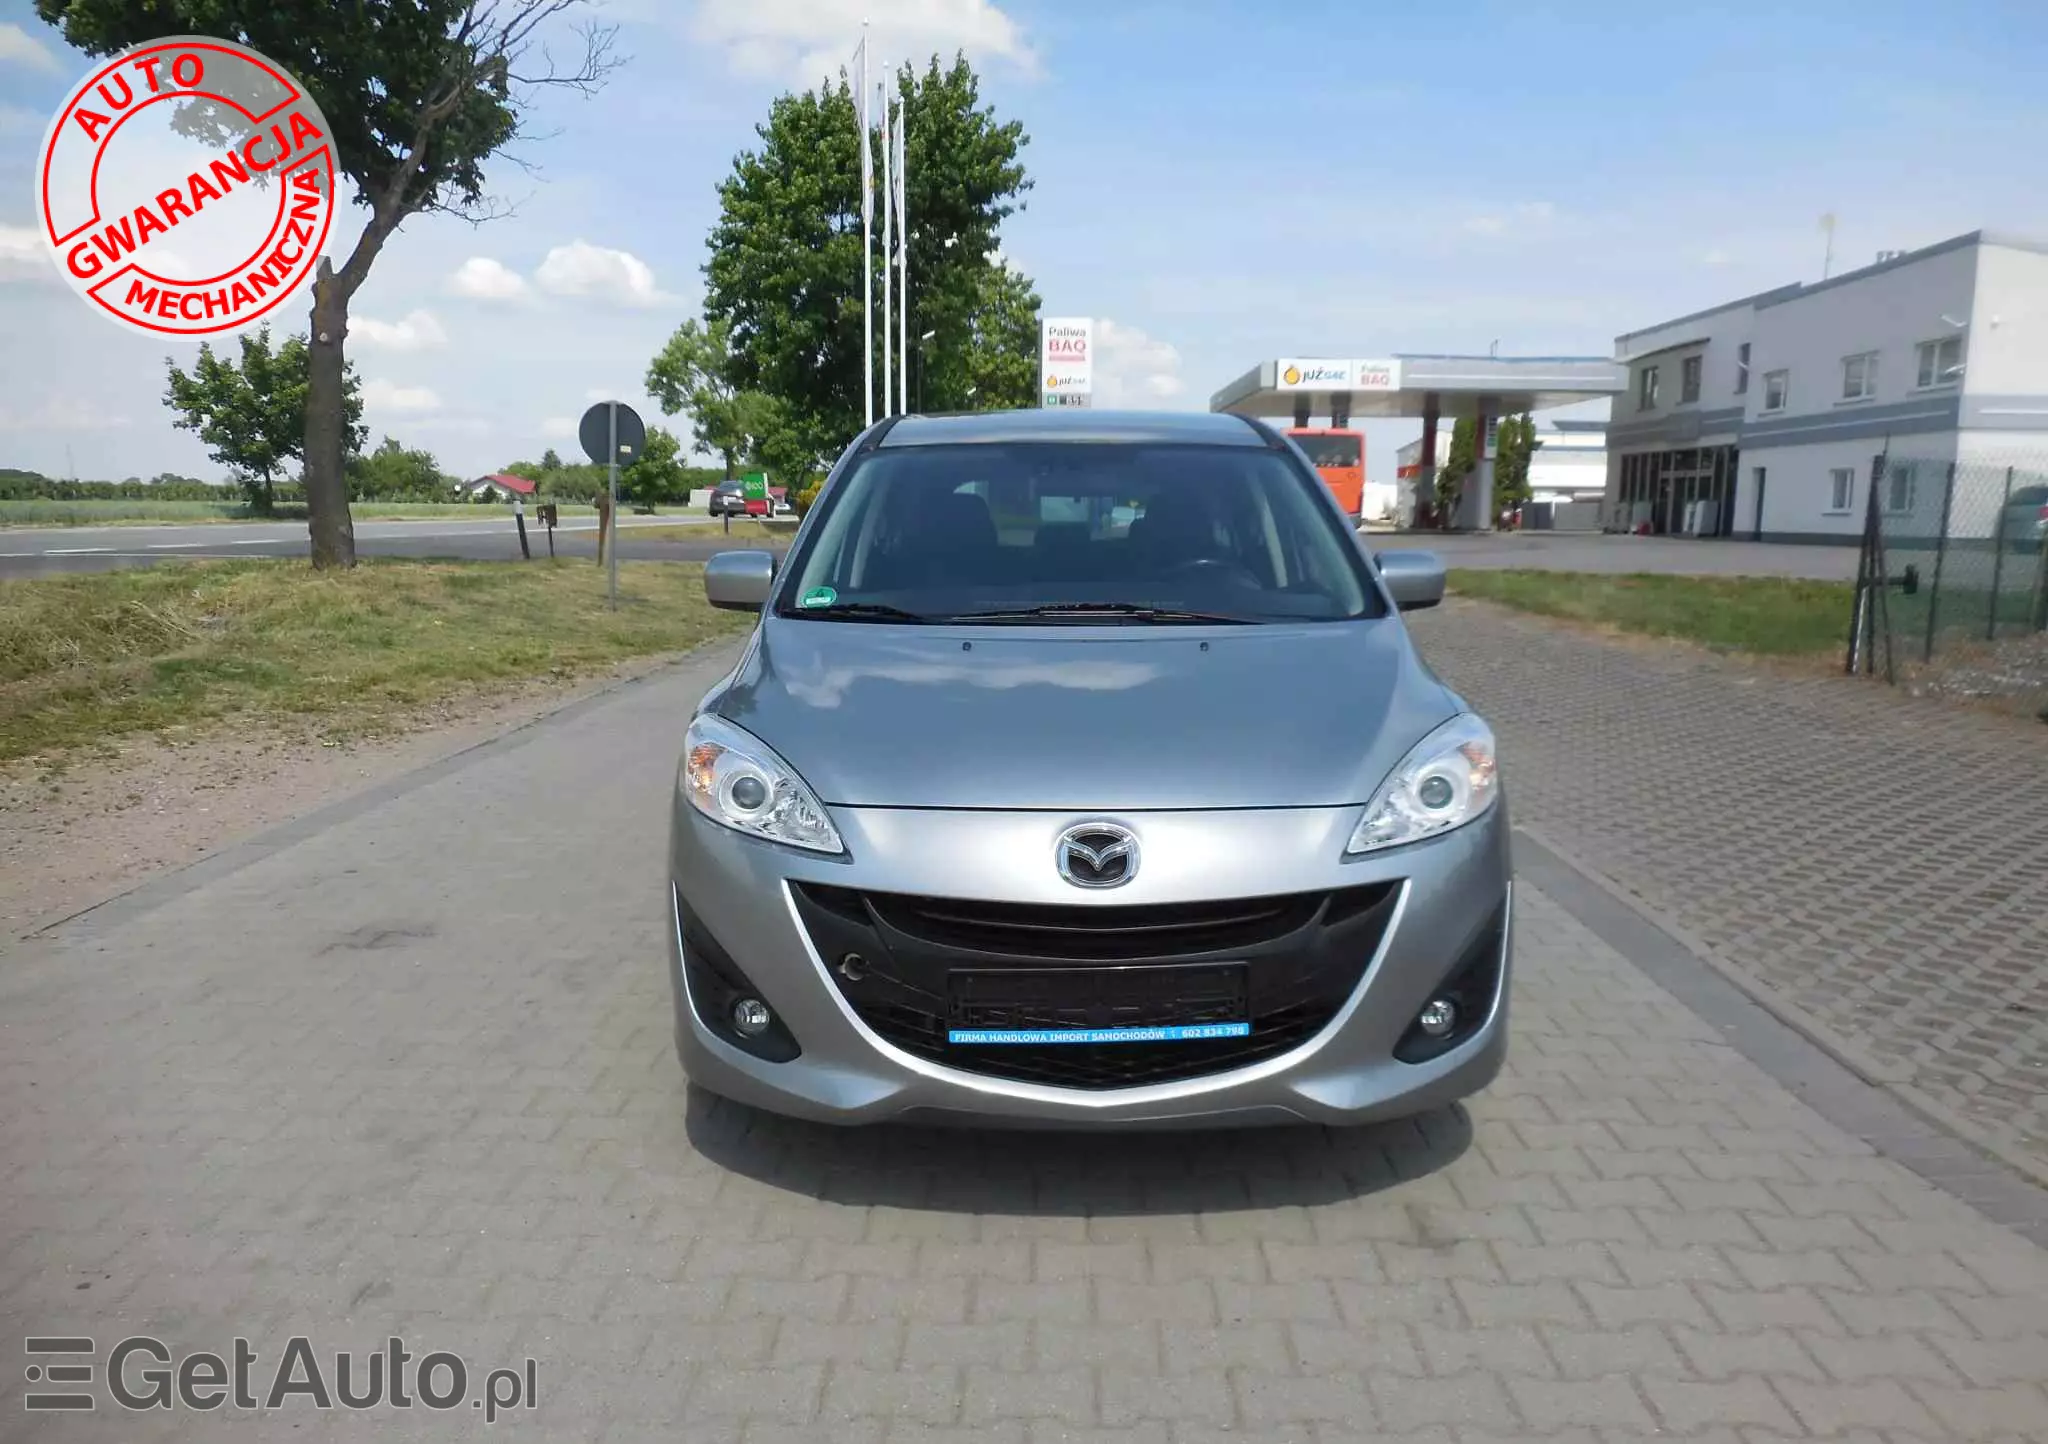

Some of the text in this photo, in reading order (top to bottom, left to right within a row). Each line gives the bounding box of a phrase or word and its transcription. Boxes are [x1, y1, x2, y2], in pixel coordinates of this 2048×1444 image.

[1048, 327, 1087, 337] Paliwa
[955, 1033, 987, 1042] FIRMA
[989, 1032, 1047, 1042] HANDLOWA
[1051, 1032, 1089, 1042] IMPORT
[1182, 1027, 1201, 1038] 602
